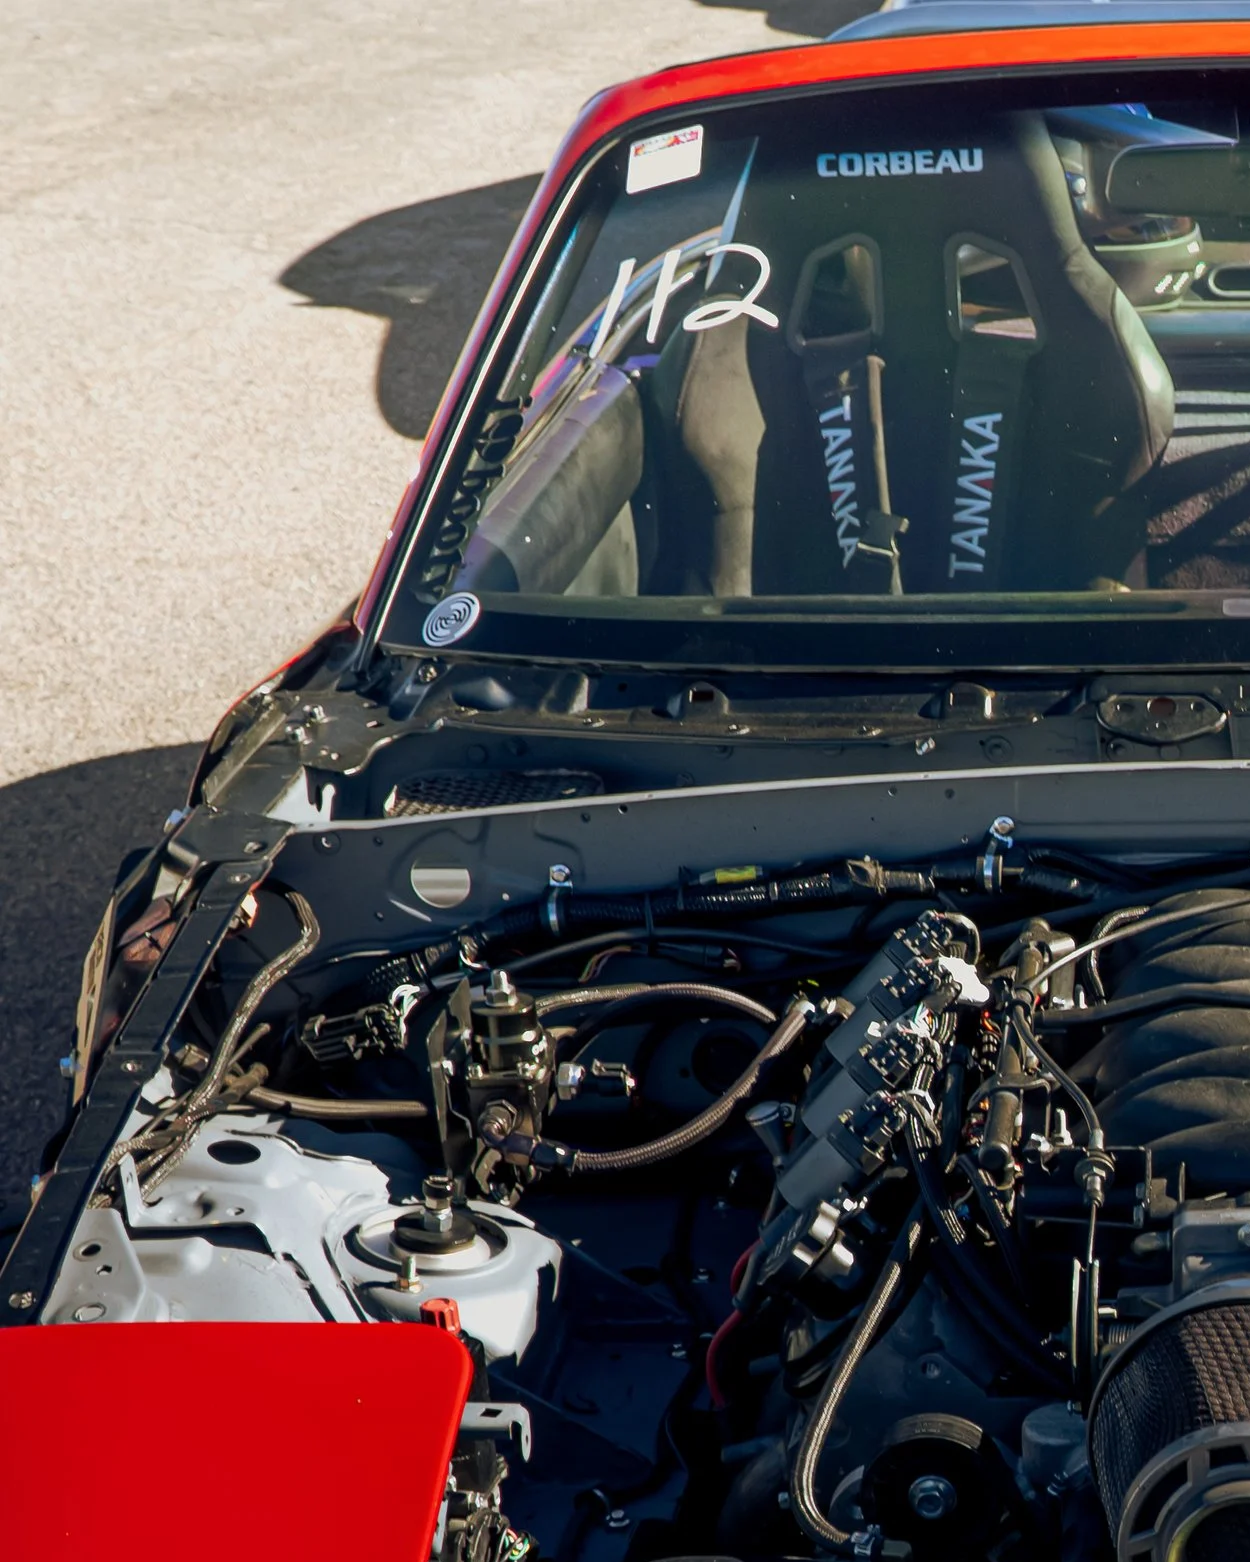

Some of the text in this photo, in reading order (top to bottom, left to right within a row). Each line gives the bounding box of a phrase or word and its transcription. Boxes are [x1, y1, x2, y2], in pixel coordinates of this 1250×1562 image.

[816, 148, 984, 178] CORBEAU
[819, 394, 862, 570] TANAKA
[949, 412, 1004, 579] TANAKA
